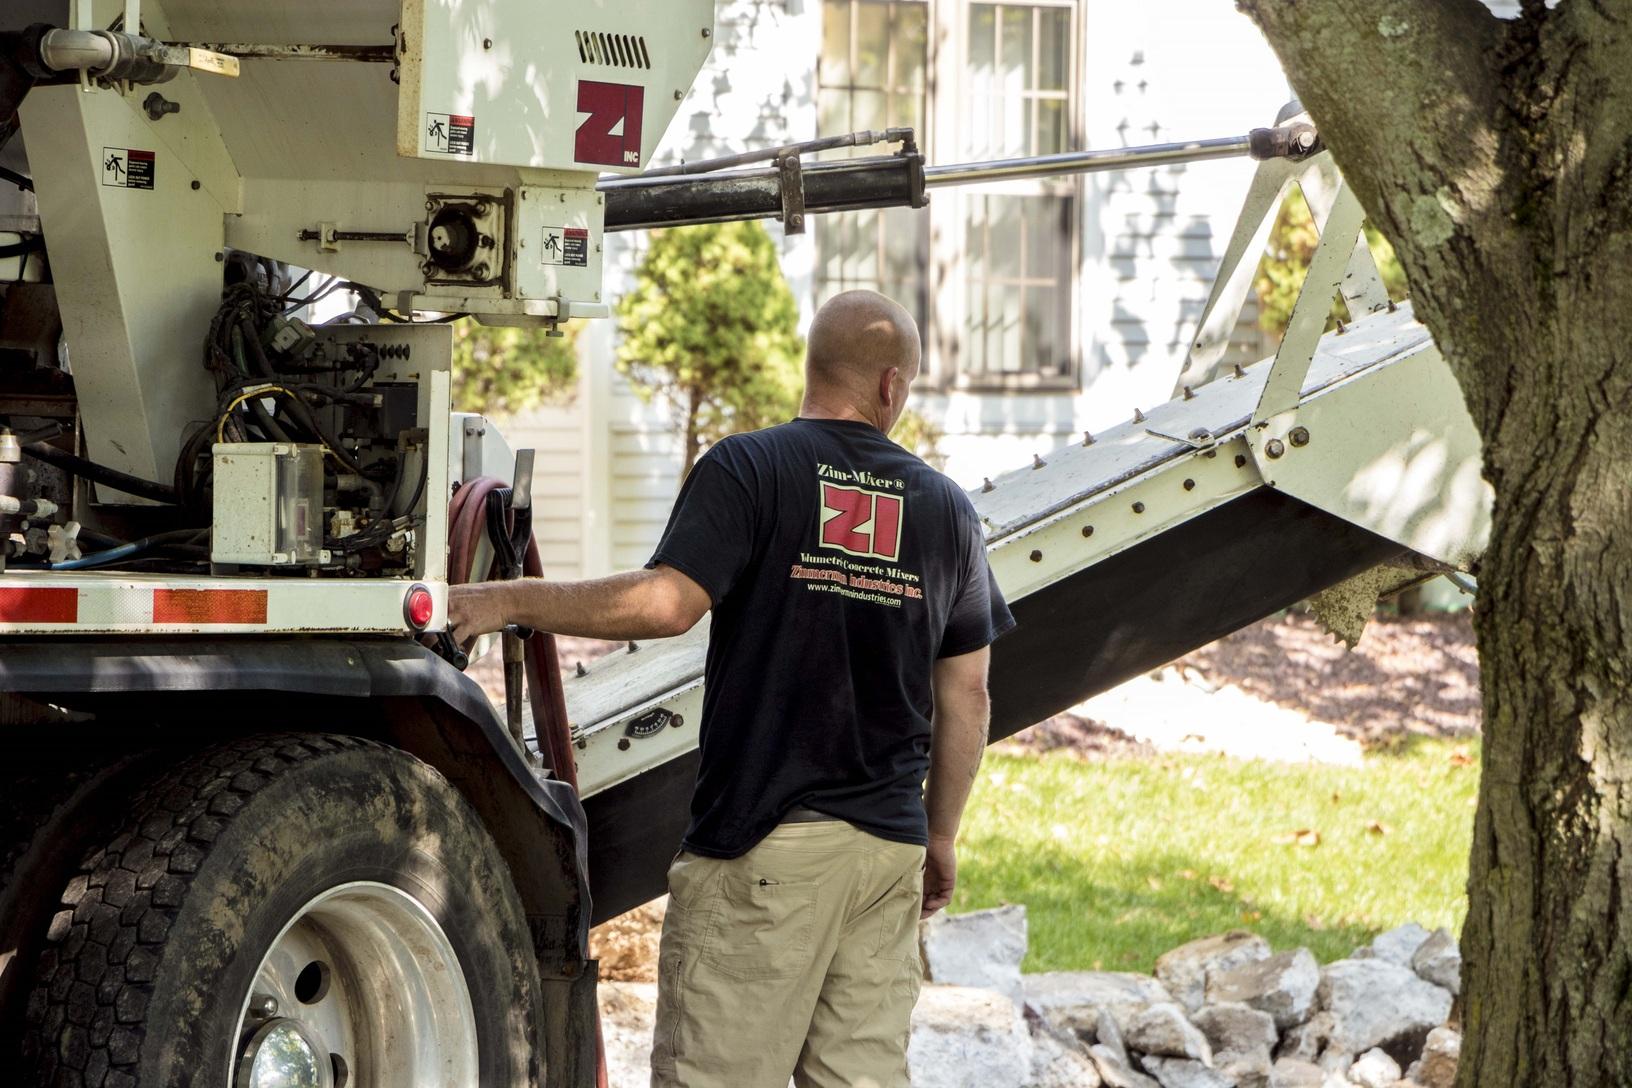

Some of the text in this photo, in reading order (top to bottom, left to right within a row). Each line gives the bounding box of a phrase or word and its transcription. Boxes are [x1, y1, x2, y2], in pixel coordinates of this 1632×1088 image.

[624, 151, 639, 162] INC
[800, 552, 843, 567] Vlumetri
[886, 567, 920, 582] Mixers
